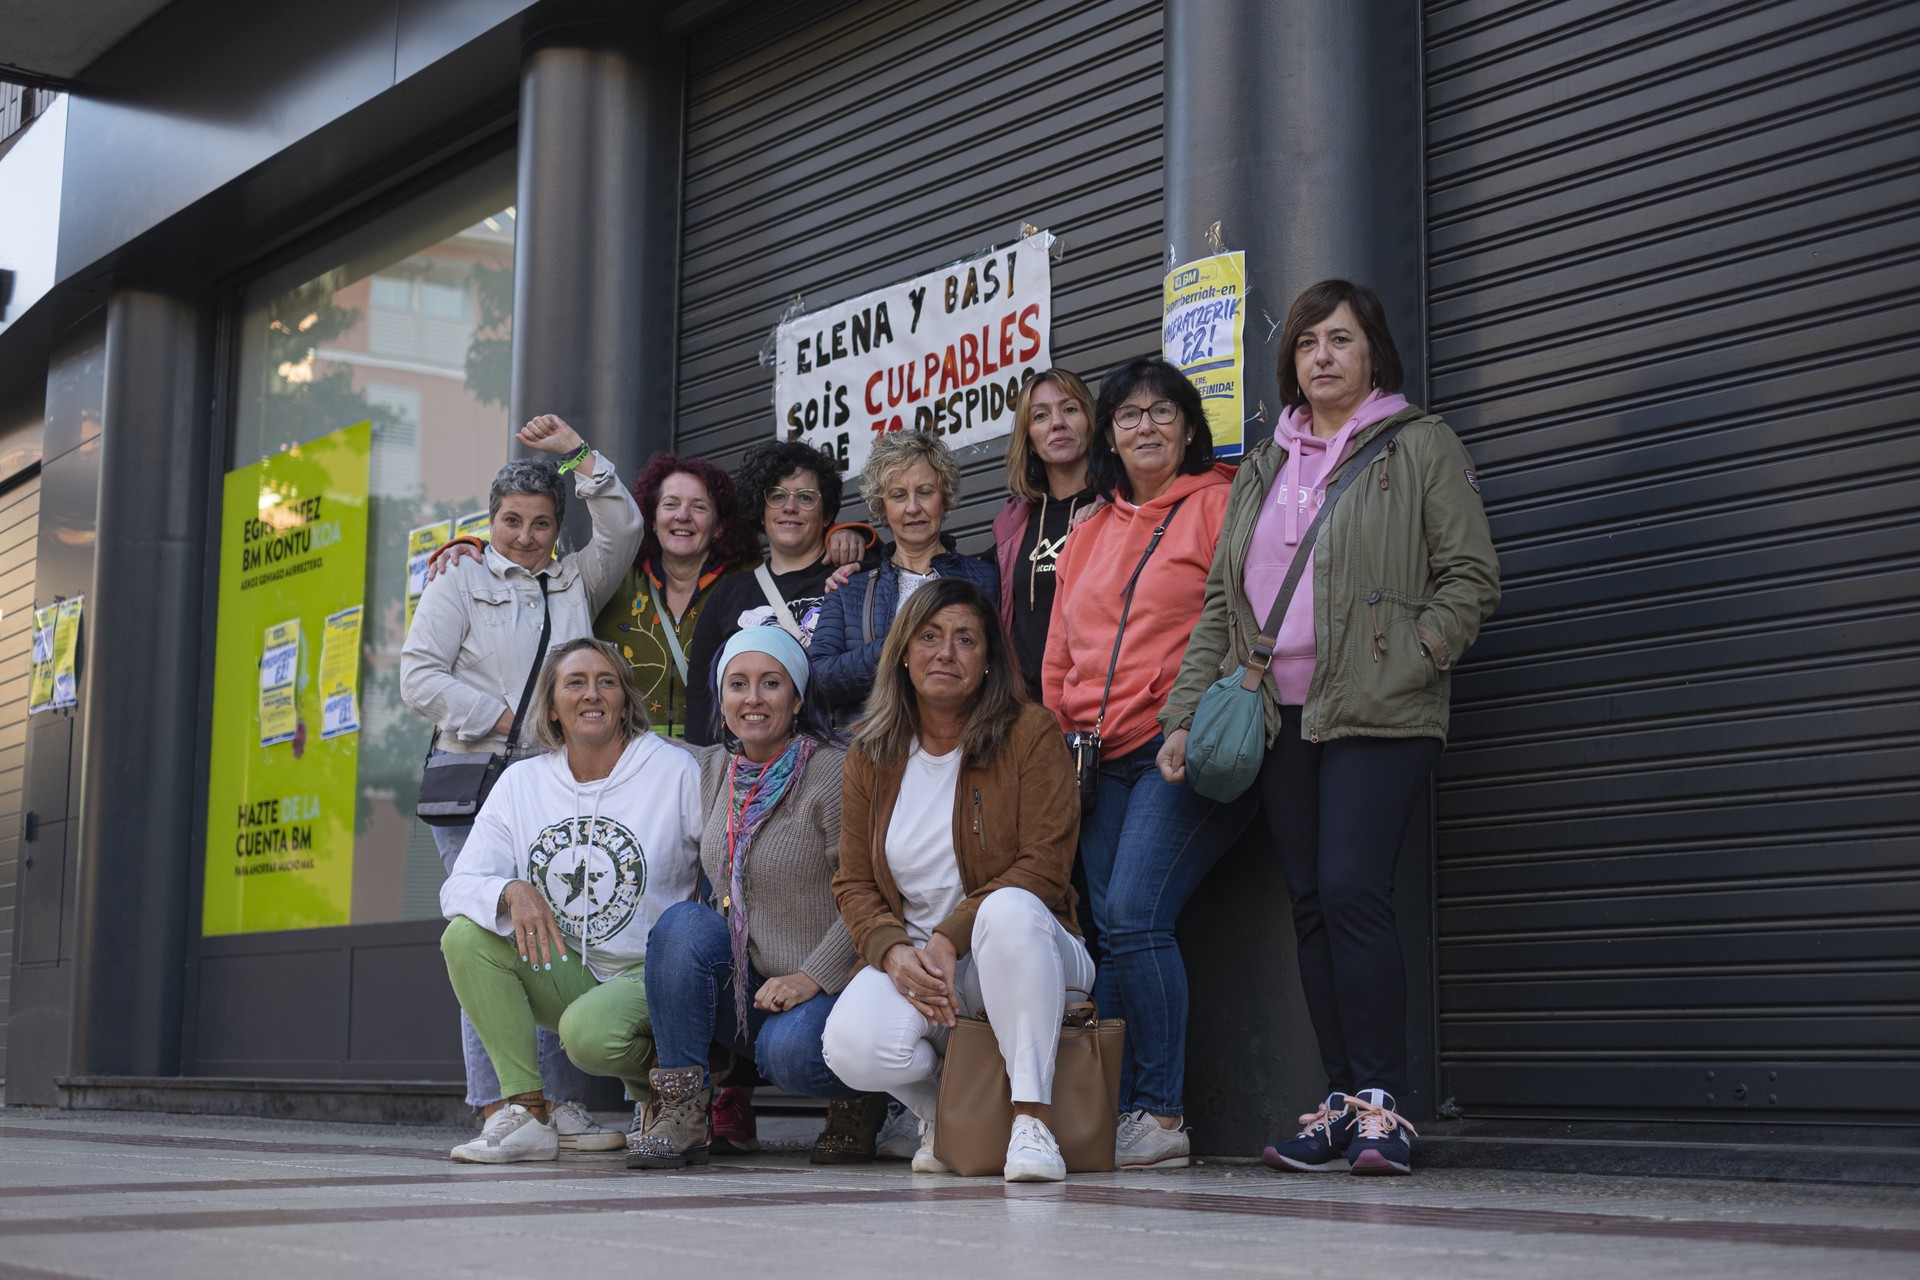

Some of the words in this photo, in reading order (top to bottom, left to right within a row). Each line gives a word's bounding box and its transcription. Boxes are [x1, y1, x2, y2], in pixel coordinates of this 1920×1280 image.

[1182, 270, 1197, 285] BM
[796, 301, 894, 376] ELENA
[908, 286, 926, 334] Y
[944, 251, 1017, 314] BASI
[864, 303, 1041, 415] CULPABLES
[242, 547, 261, 572] BM
[264, 520, 342, 565] KONTUKOA
[237, 798, 279, 828] HAZTE
[281, 795, 300, 823] DE
[302, 793, 322, 821] LA
[236, 828, 288, 858] CUENTA
[291, 825, 312, 851] BM
